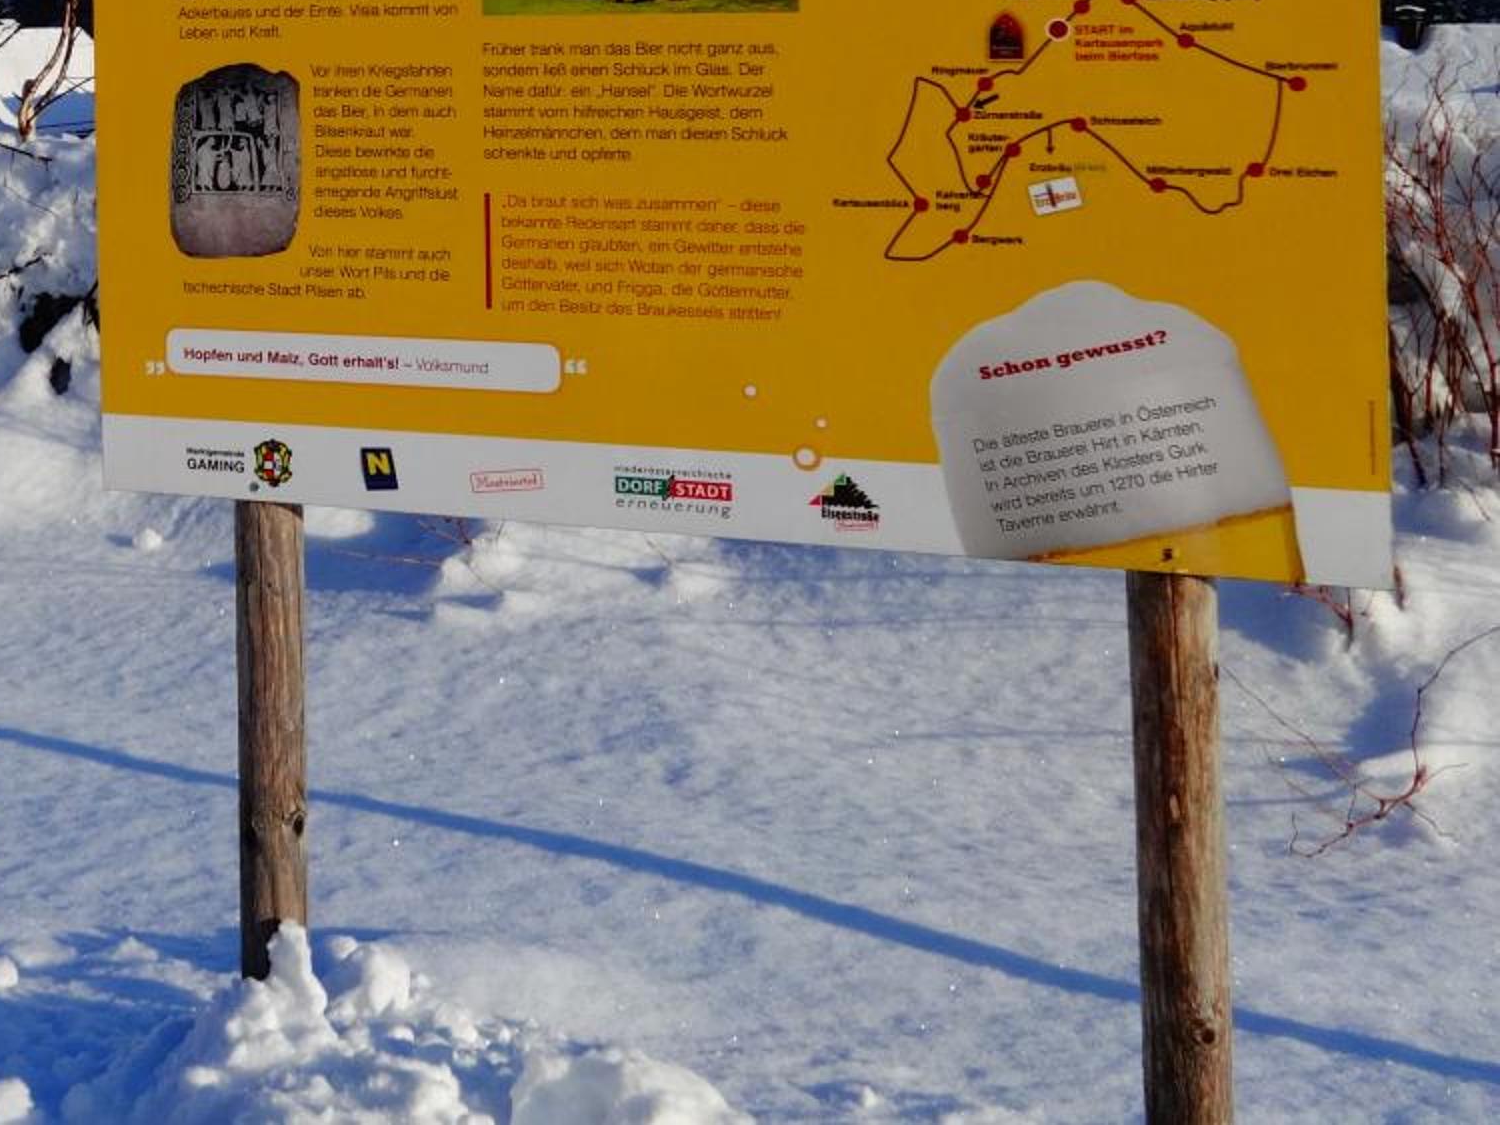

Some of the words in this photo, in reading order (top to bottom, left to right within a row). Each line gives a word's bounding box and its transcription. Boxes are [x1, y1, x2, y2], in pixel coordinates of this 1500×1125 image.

[184, 347, 233, 364] Hopfen
[237, 350, 263, 364] und
[308, 353, 338, 367] Gott
[415, 357, 489, 375] Volksmund
[979, 355, 1050, 380] Schon
[1056, 330, 1167, 368] gewusst?
[972, 438, 998, 453] Die
[1054, 417, 1115, 438] Brauerei
[1119, 412, 1132, 425] in
[1138, 396, 1217, 423] Österreich
[187, 458, 244, 473] GAMING
[366, 452, 390, 475] N
[980, 457, 995, 472] ist
[999, 454, 1023, 469] die
[1027, 442, 1088, 464] Brauerei
[1092, 435, 1119, 453] Hirt
[1123, 433, 1136, 446] in
[985, 478, 998, 493] In
[1003, 466, 1067, 491] Archiven
[1072, 460, 1098, 478] des
[1102, 449, 1164, 471] Klosters
[618, 479, 662, 494] DORF
[676, 484, 730, 499] STADT
[990, 496, 1022, 513] wird
[1026, 487, 1074, 509] bereits
[1080, 484, 1104, 496] um
[1109, 474, 1145, 493] 1270
[1149, 469, 1172, 484] die
[1176, 460, 1219, 478] Hirter
[616, 498, 731, 519] erneuerung
[996, 513, 1054, 532] Taverne
